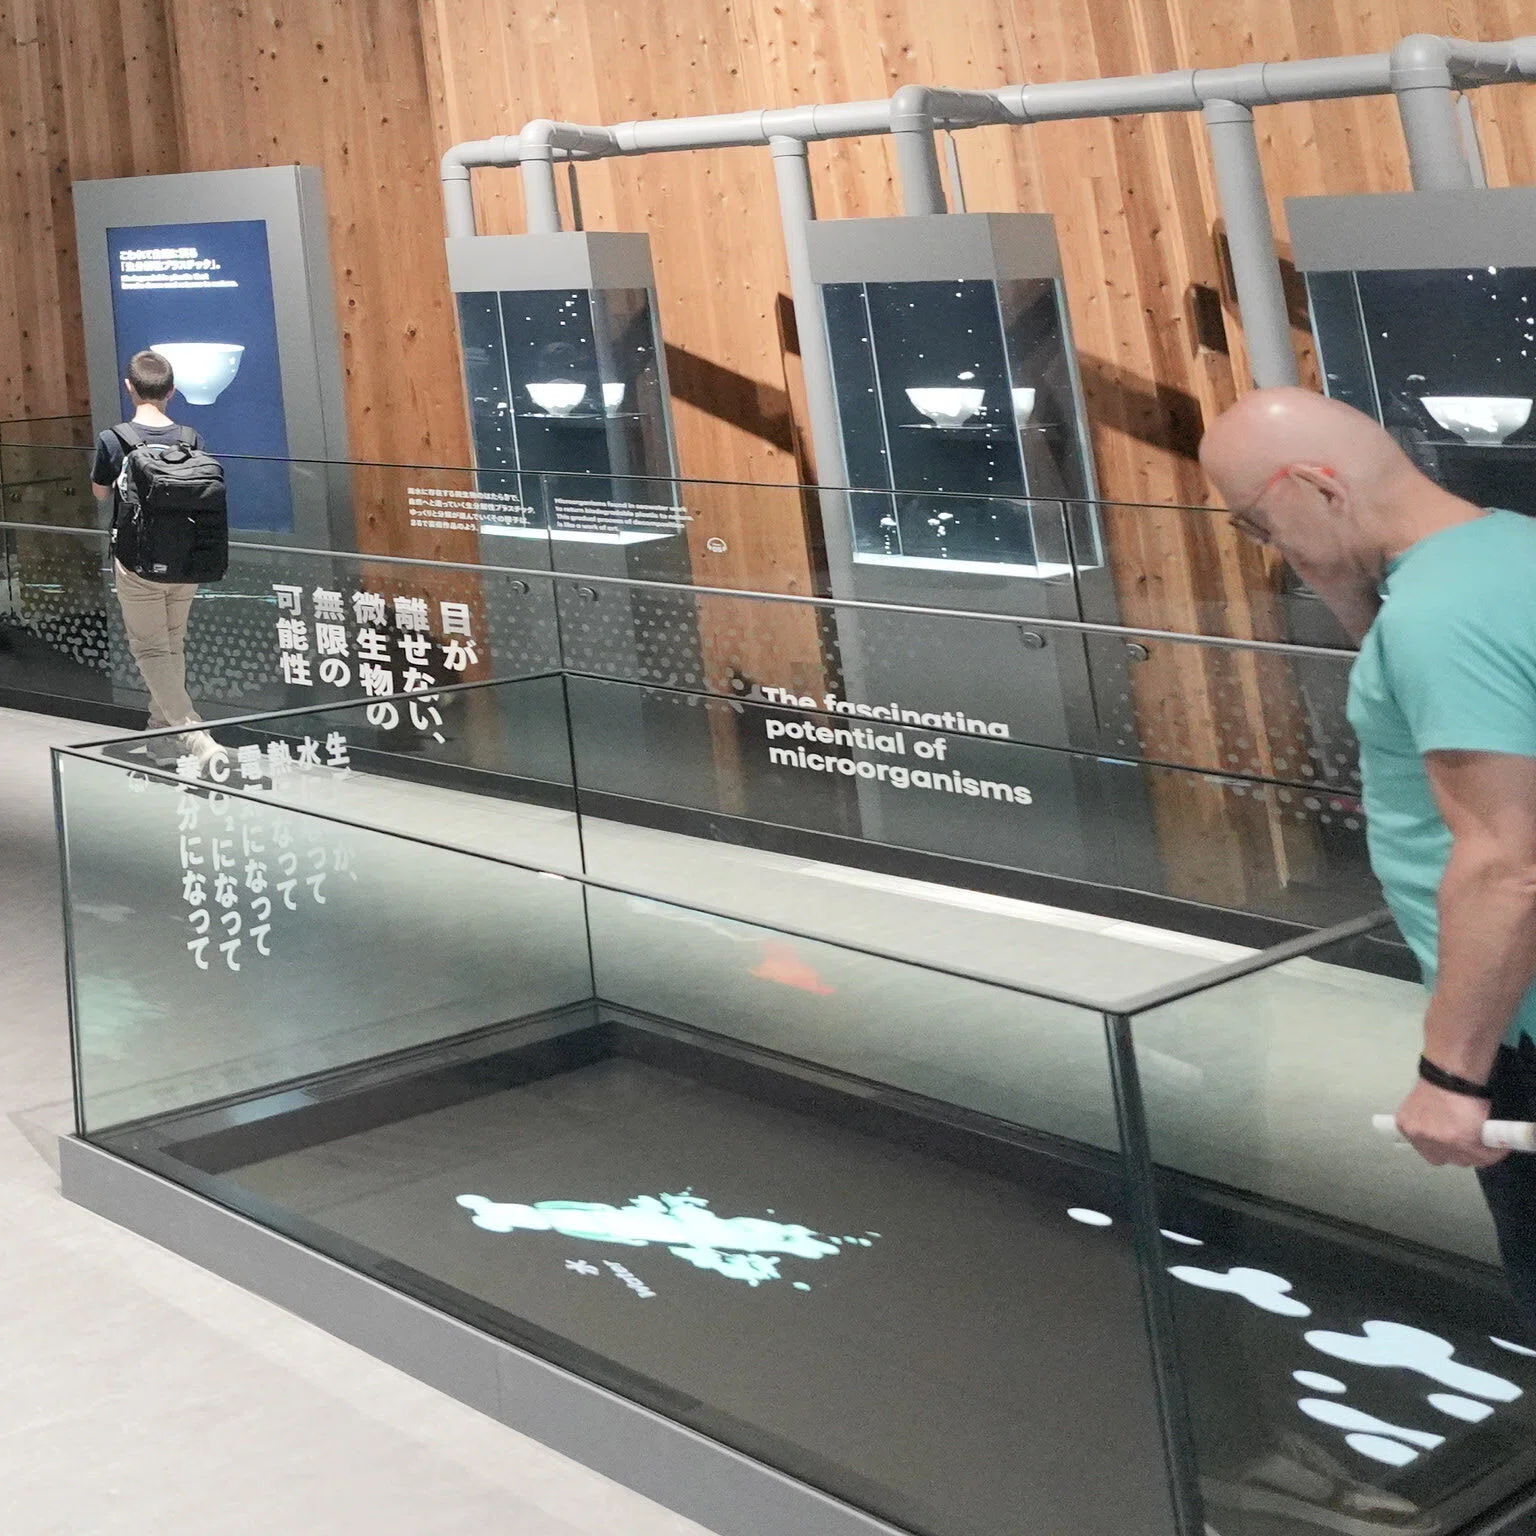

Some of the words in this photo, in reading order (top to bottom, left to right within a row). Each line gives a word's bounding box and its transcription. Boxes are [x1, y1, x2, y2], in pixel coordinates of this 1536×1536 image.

[272, 583, 313, 687] 可能性
[312, 586, 351, 688] 無限の
[352, 590, 399, 731] 微生物の
[393, 595, 446, 744] 離せない、
[439, 600, 479, 672] 目が
[761, 685, 817, 710] The
[824, 692, 1010, 739] fascinating
[766, 717, 905, 756] potential
[913, 737, 947, 762] of
[769, 744, 1033, 806] microorganisms
